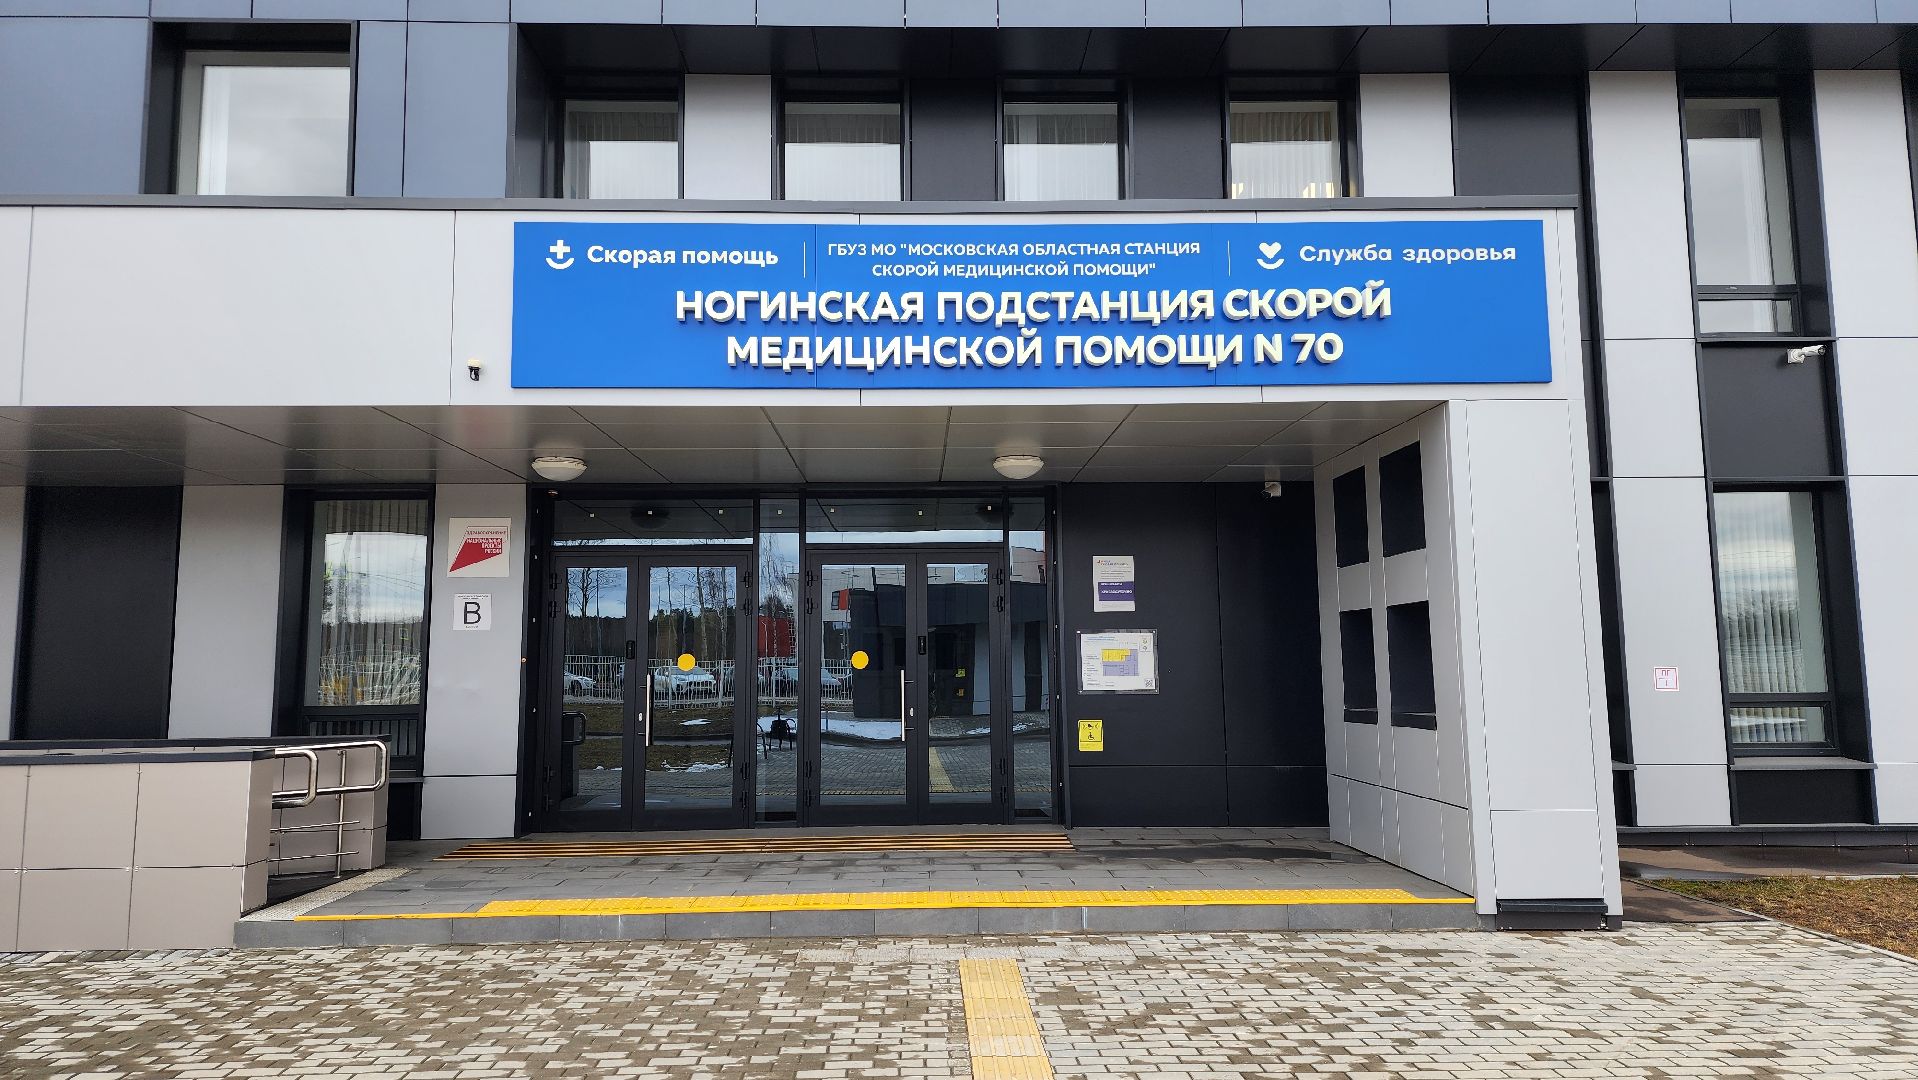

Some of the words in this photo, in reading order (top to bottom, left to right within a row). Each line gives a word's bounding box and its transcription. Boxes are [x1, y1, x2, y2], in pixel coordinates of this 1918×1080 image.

[586, 245, 676, 269] Скорая
[682, 250, 779, 268] помощь
[828, 243, 867, 256] ГБУЗ
[871, 243, 896, 256] МО
[900, 243, 1019, 256] "МОСКОВСКАЯ
[1022, 242, 1121, 256] ОБЛАСТНАЯ
[1124, 242, 1201, 257] СТАНЦИЯ
[1299, 244, 1392, 266] Служба
[1402, 246, 1516, 265] здоровья
[871, 260, 939, 277] СКОРОЙ
[943, 259, 1069, 278] МЕДИЦИНСКОЙ
[1073, 262, 1156, 278] ПОМОЩИ"
[676, 290, 924, 323] НОГИНСКАЯ
[937, 289, 1215, 327] ПОДСТАНЦИЯ
[1222, 280, 1392, 320] СКОРОЙ
[726, 327, 1043, 373] МЕДИЦИНСКОЙ
[1055, 333, 1243, 370] ПОМОЩИ
[1253, 334, 1283, 363] N
[1291, 332, 1344, 363] 70
